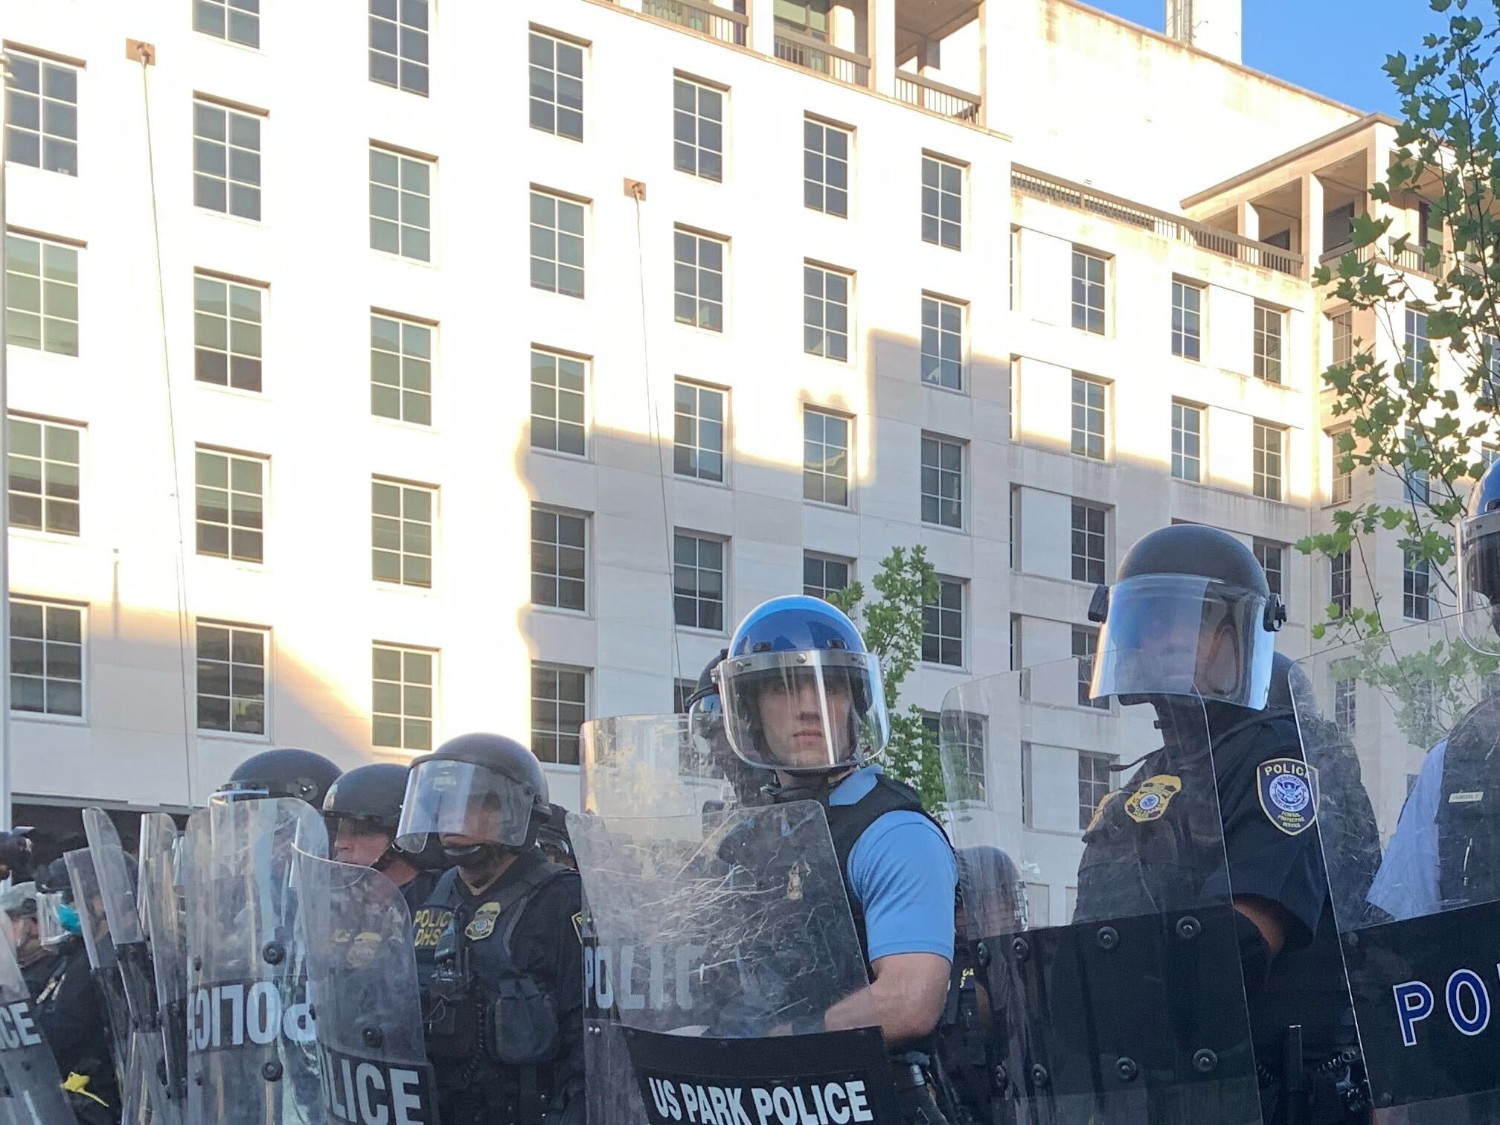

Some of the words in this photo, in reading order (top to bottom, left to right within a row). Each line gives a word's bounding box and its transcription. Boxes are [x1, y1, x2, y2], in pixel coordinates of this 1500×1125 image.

[413, 909, 450, 928] POLIC
[414, 928, 442, 947] DHS
[584, 945, 707, 1010] POLIC
[0, 1002, 42, 1050] CE
[648, 1077, 682, 1121] US
